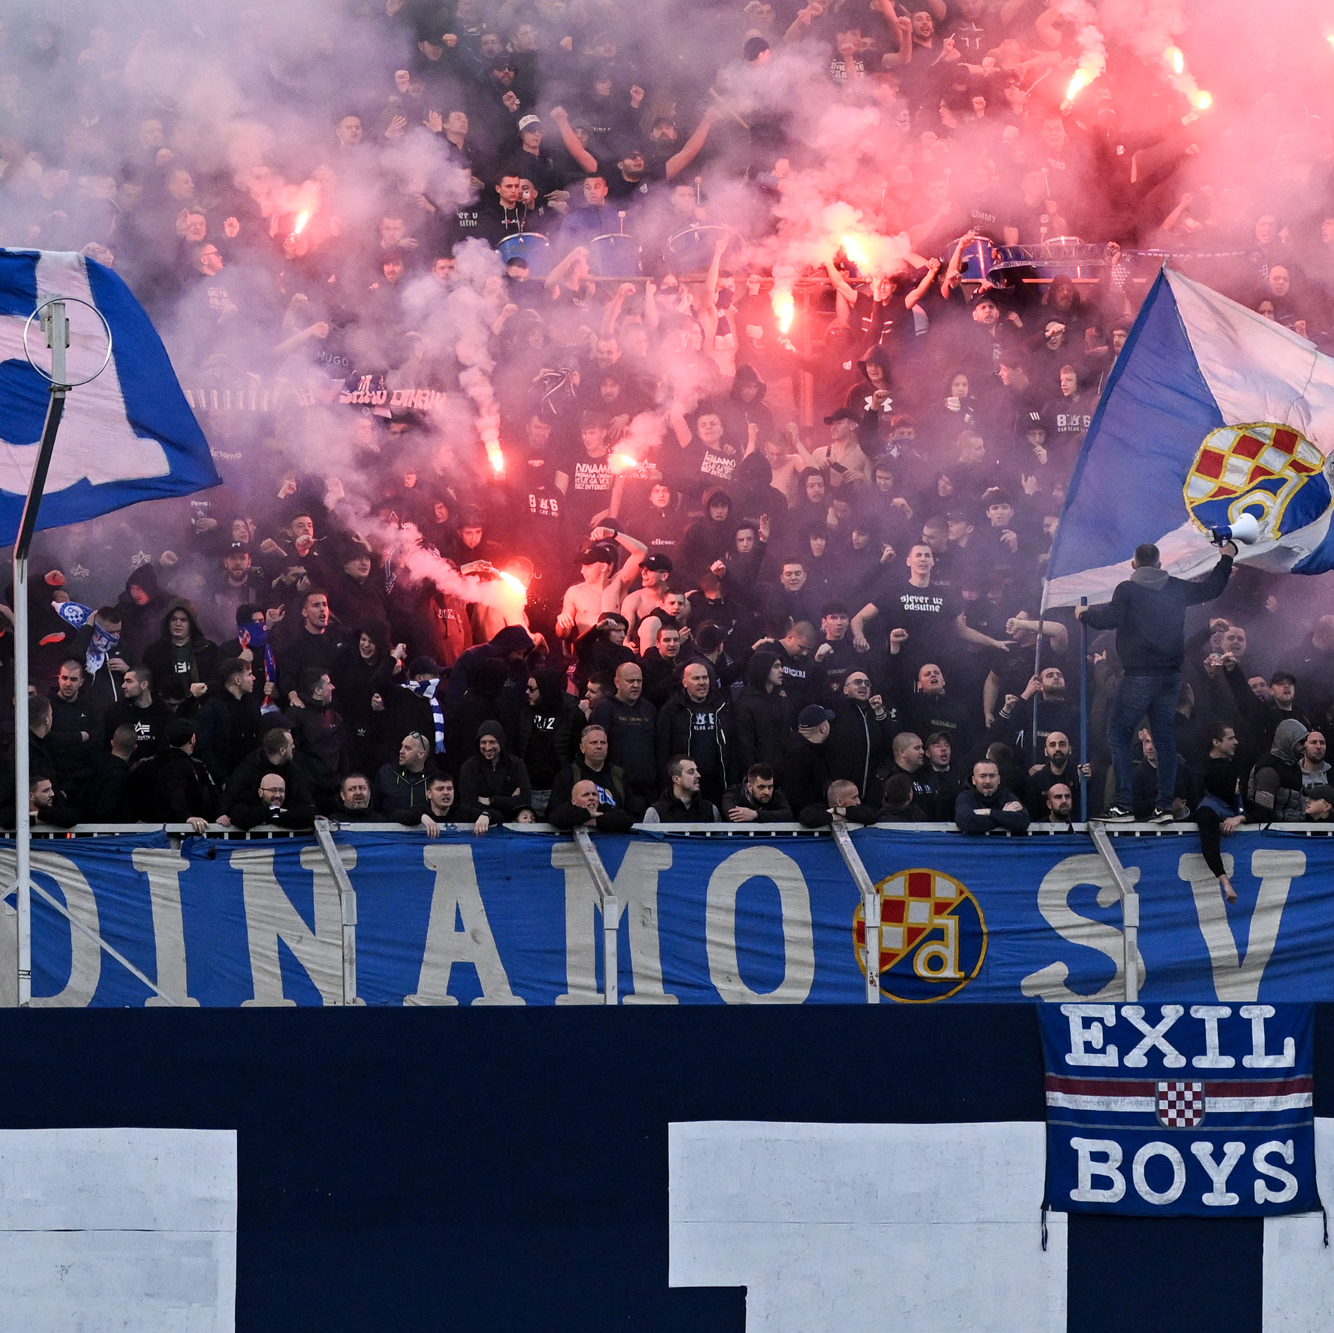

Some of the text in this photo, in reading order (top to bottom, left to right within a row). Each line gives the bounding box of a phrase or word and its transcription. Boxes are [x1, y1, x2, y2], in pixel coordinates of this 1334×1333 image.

[316, 349, 349, 367] HUGO
[900, 593, 943, 605] sjever uz
[904, 603, 941, 612] odsutne
[1060, 1003, 1298, 1068] EXIL
[1067, 1136, 1301, 1207] BOYS
